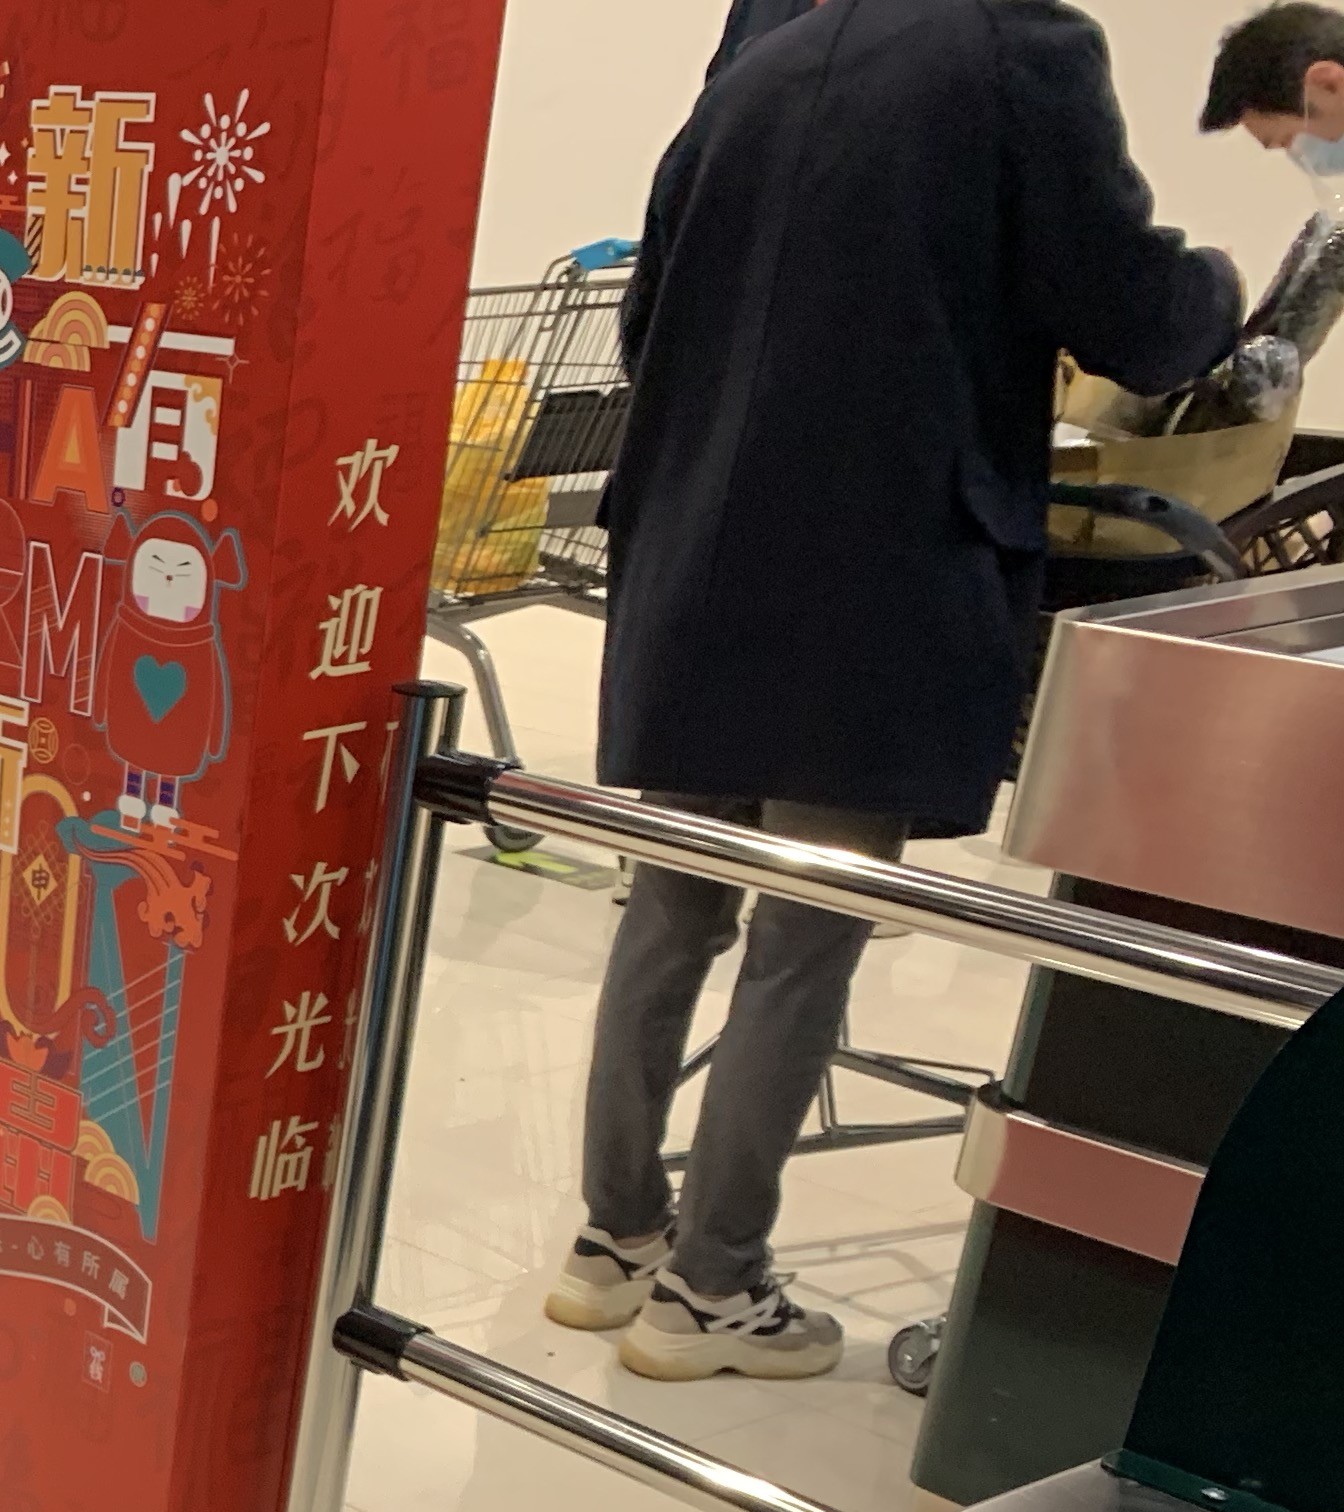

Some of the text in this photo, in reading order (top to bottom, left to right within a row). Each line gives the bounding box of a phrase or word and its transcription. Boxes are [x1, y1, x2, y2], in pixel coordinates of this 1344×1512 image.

[28, 85, 157, 290] 新
[249, 438, 399, 1201] 欢迎下次光临
